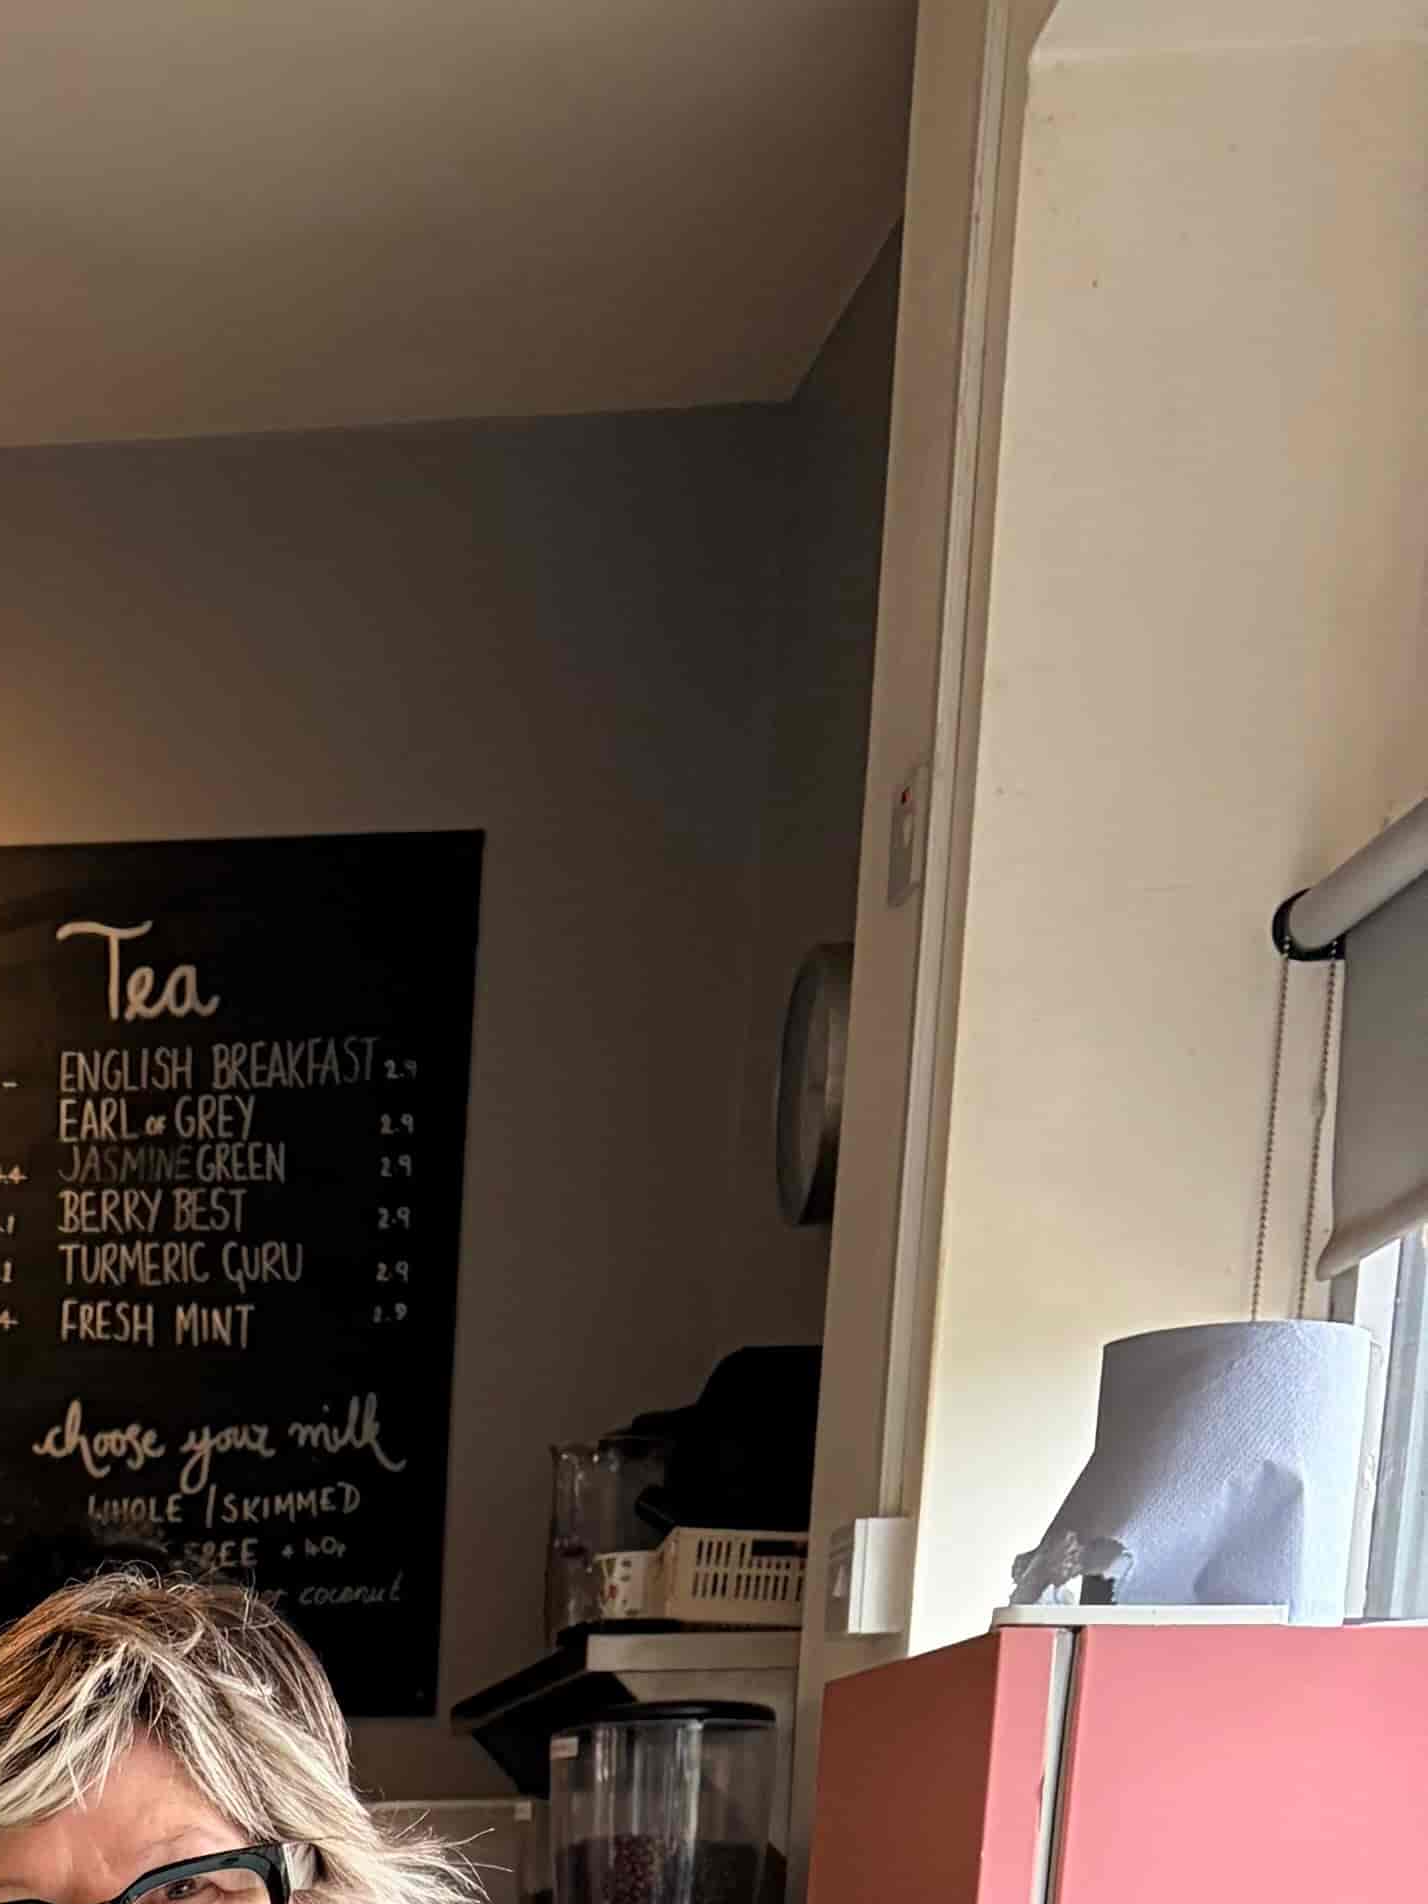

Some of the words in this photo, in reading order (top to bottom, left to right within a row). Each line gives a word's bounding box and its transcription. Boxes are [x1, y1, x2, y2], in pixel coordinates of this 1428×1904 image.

[56, 920, 220, 1022] Tea
[60, 1045, 193, 1093] ENGLISH
[212, 1036, 380, 1089] BREAKFAST
[59, 1097, 139, 1143] EARL
[174, 1094, 255, 1141] GREY
[58, 1145, 193, 1184] JASMINE
[197, 1142, 286, 1184] GREEN
[56, 1190, 162, 1234] BERRY
[174, 1188, 246, 1232] BEST
[58, 1242, 210, 1286] TURMERIC
[222, 1241, 302, 1291] GURU
[61, 1301, 155, 1346] FRESH
[176, 1303, 256, 1349] MINT
[32, 1397, 165, 1478] choose
[179, 1423, 276, 1495] your
[288, 1392, 407, 1473] milk
[87, 1493, 183, 1526] WHOLE
